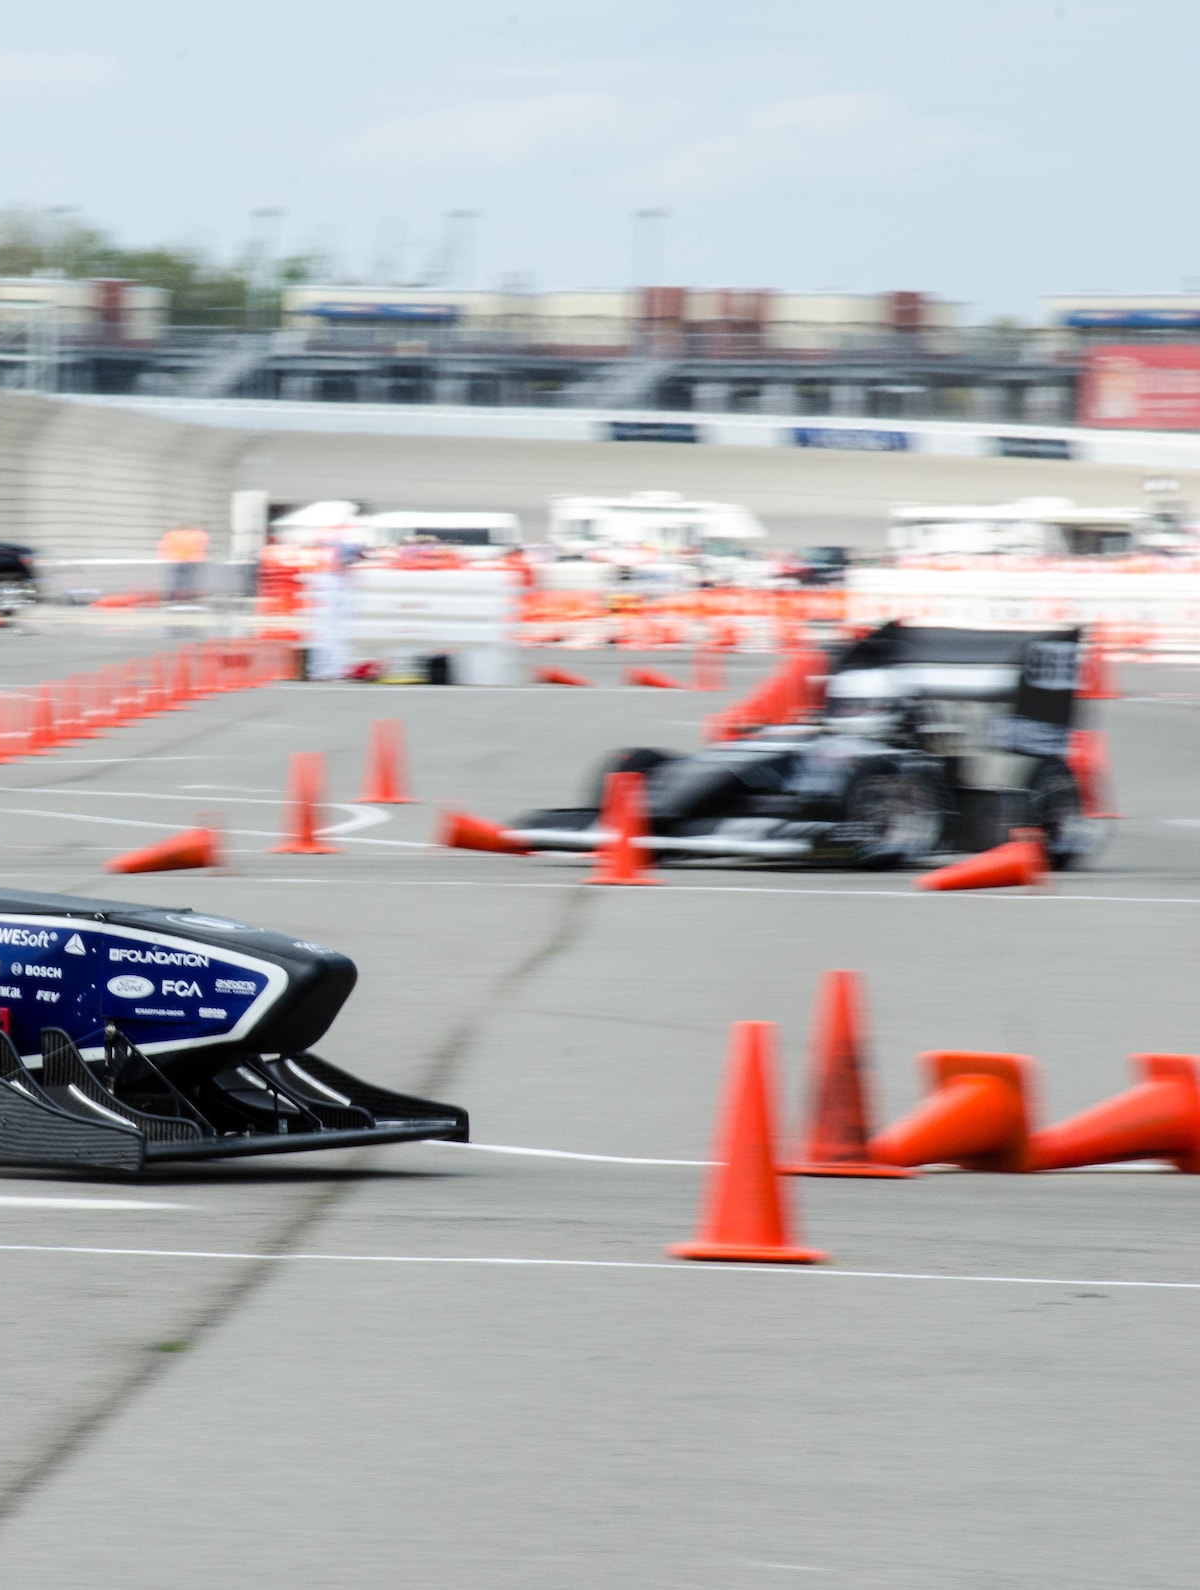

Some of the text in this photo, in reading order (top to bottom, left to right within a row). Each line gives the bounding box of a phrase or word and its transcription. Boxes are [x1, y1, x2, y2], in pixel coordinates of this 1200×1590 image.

[119, 950, 209, 967] FOUNDATION
[25, 965, 62, 979] BOSCH
[36, 989, 61, 1003] FEV
[161, 979, 203, 998] FCA
